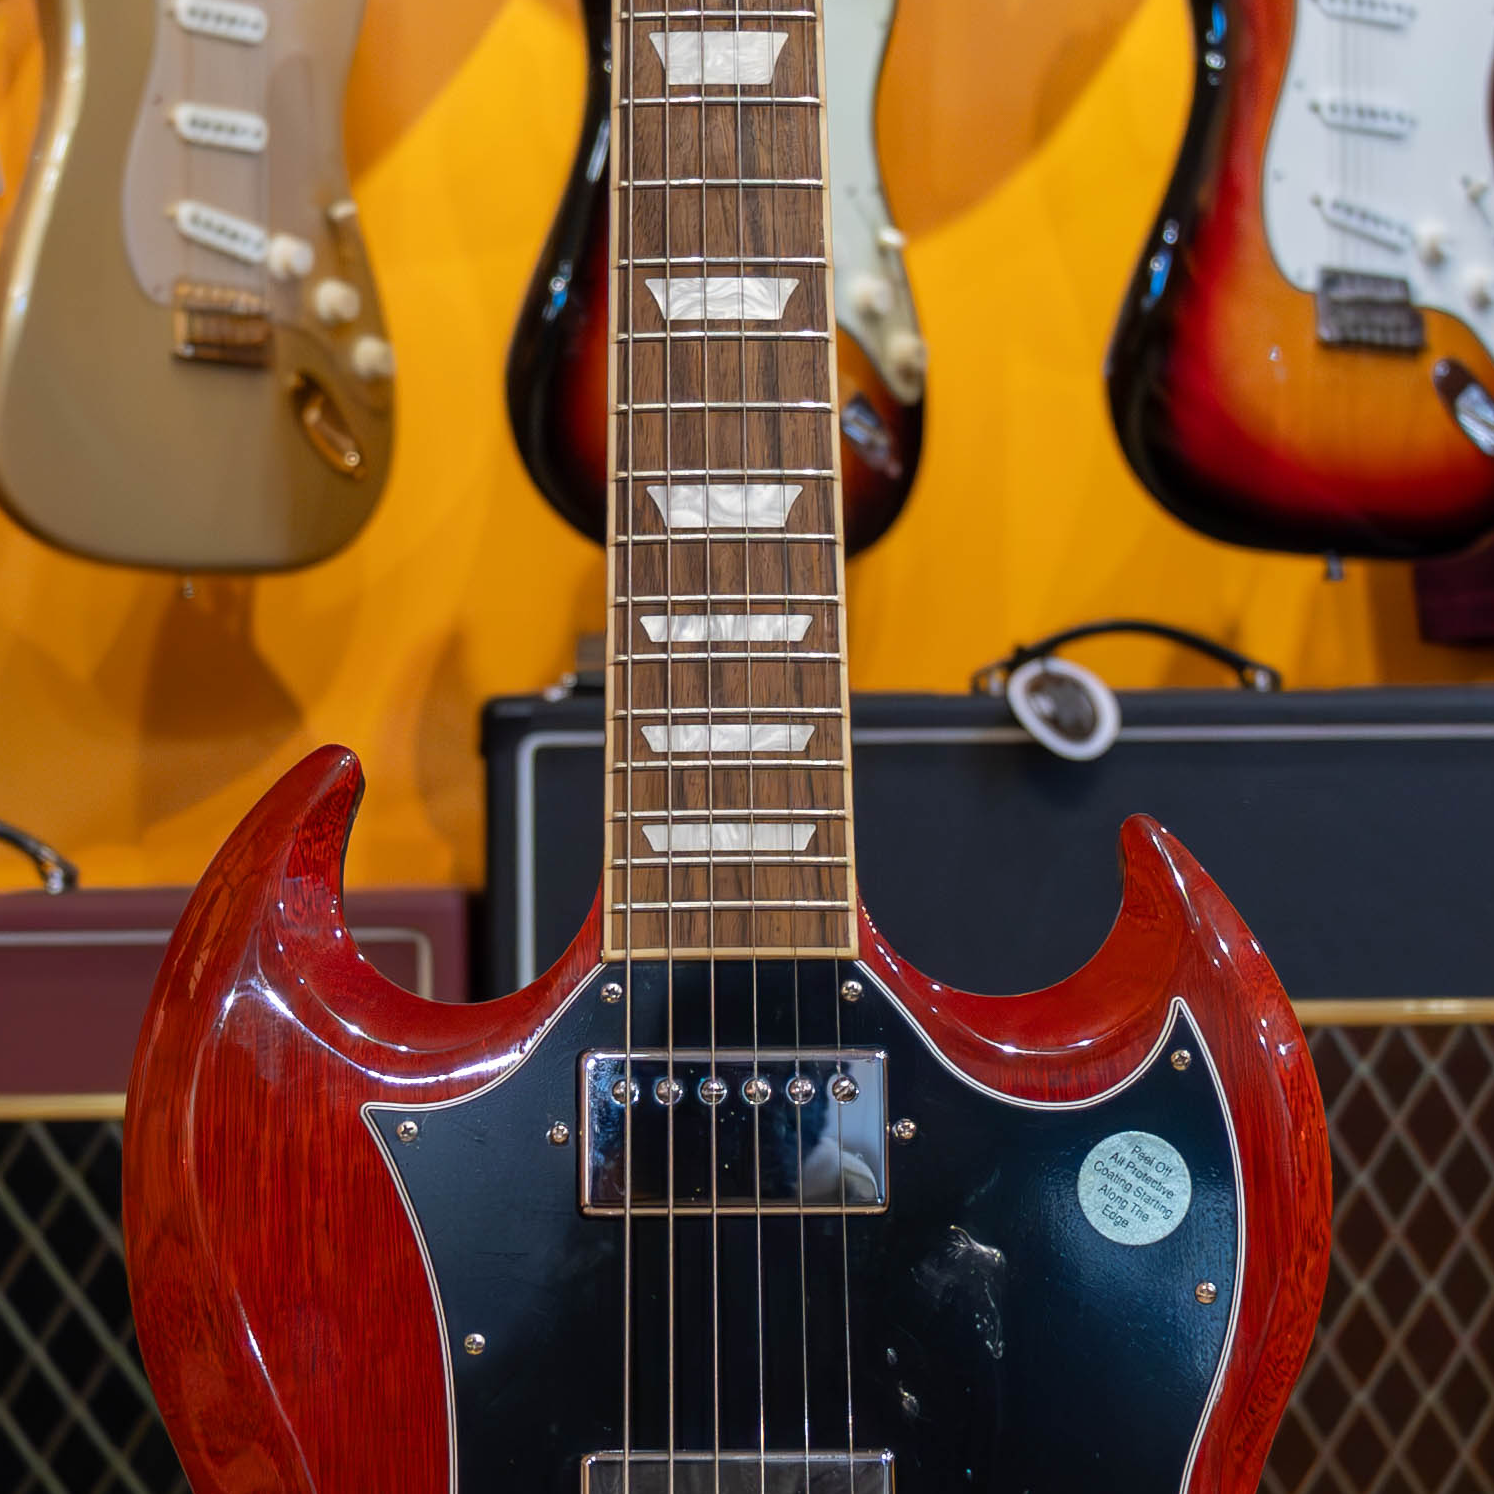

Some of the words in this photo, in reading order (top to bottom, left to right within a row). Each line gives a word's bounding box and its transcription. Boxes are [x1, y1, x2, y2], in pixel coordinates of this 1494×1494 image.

[1109, 1152, 1126, 1166] All
[1125, 1161, 1174, 1199] Protective
[1131, 1145, 1155, 1166] Peel
[1155, 1161, 1174, 1177] Off
[1094, 1160, 1133, 1193] Coating
[1133, 1186, 1173, 1220] Starting
[1098, 1184, 1128, 1210] Along
[1130, 1202, 1149, 1222] The
[1102, 1204, 1129, 1228] Edge
